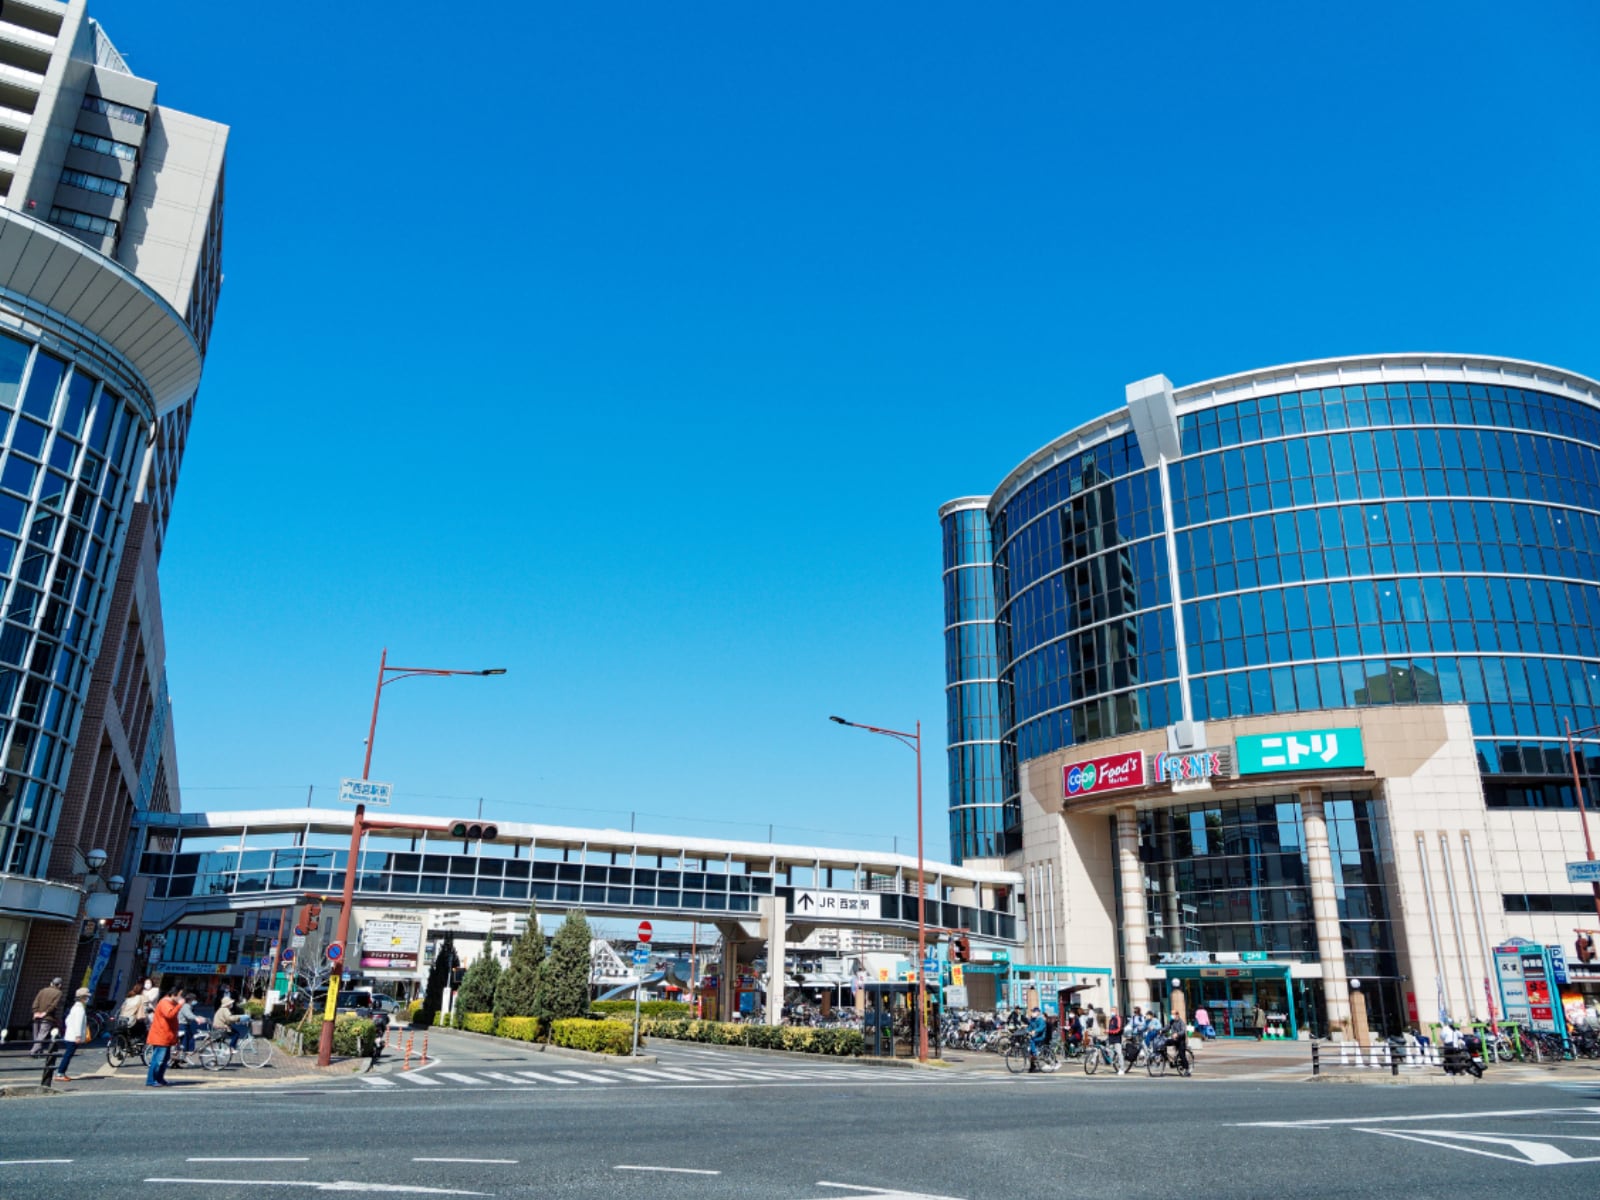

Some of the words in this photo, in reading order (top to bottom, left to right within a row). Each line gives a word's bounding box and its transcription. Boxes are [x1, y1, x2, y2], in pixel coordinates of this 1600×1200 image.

[1261, 733, 1338, 767] ニトリ
[1098, 757, 1138, 784] Food's
[1154, 751, 1221, 782] FRENTE
[819, 896, 836, 909] JR
[840, 898, 869, 910] 西宮駅
